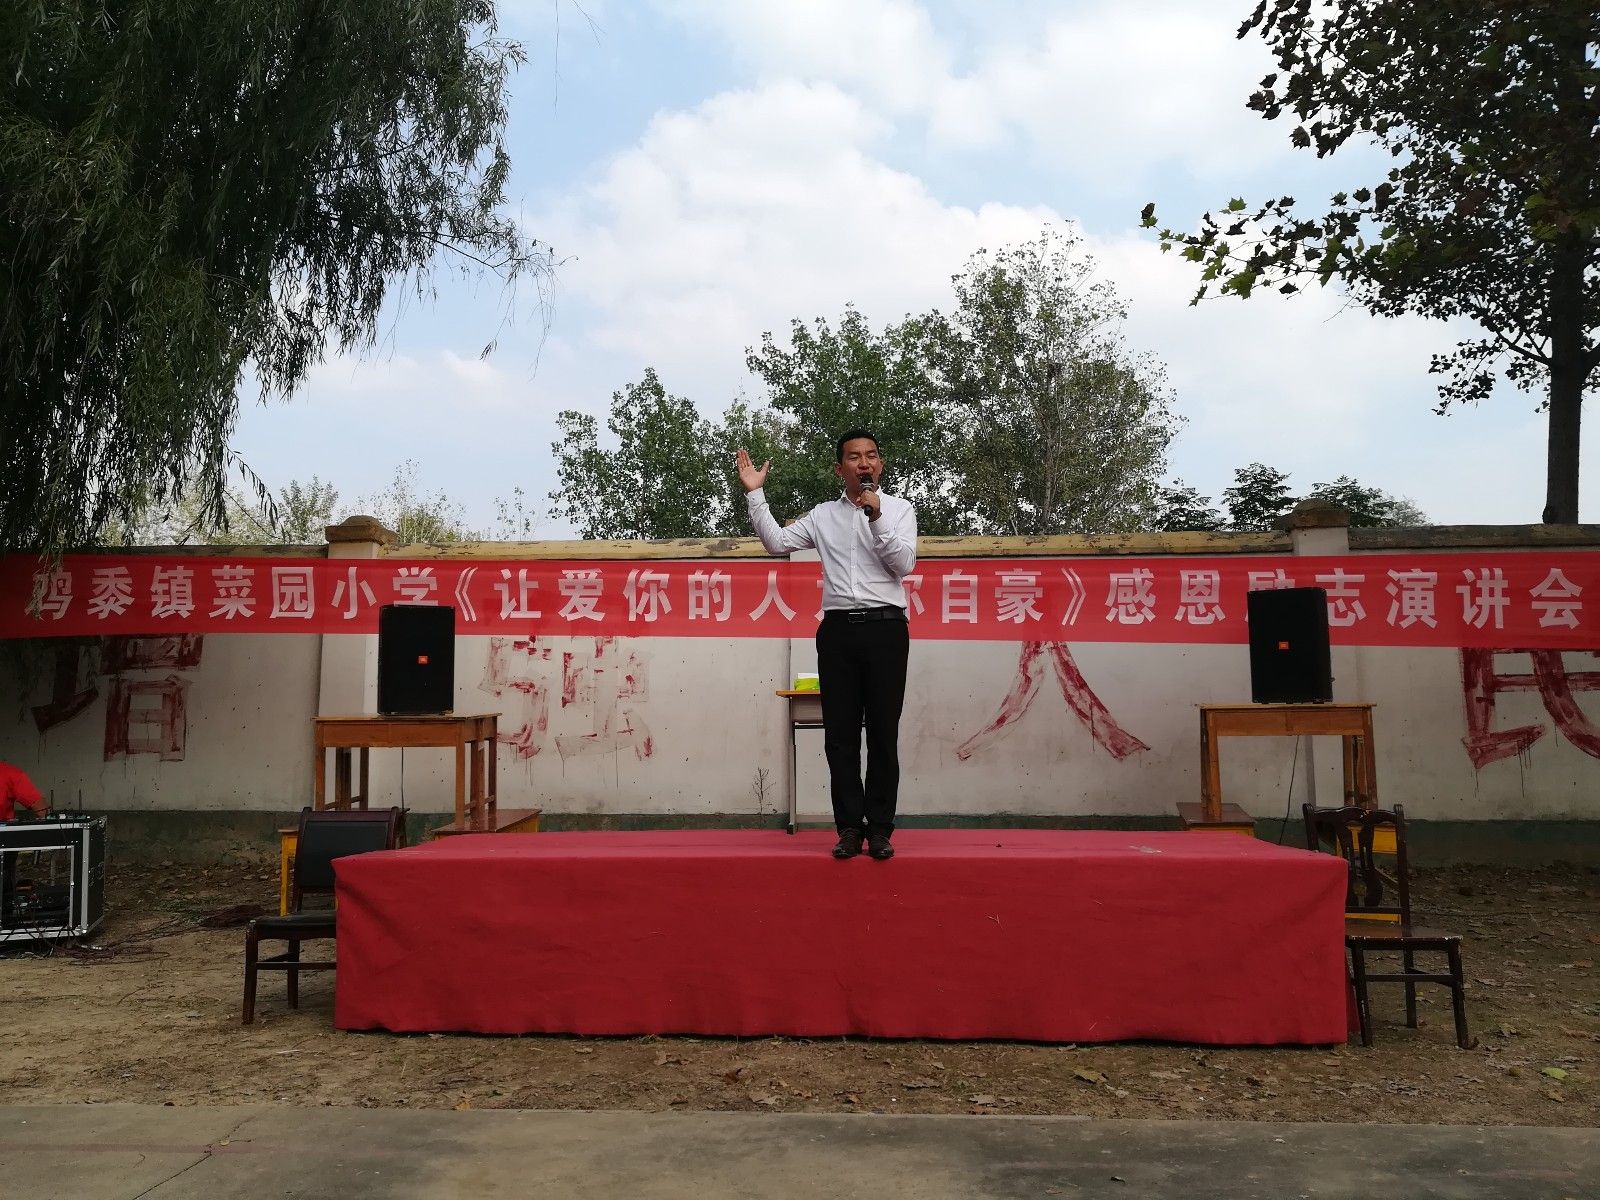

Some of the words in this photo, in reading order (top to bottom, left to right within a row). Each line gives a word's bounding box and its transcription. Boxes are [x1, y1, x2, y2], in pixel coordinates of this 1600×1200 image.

[24, 565, 1583, 630] 鸡黍镇菜园小学《让爱你的人自豪》感恩志演讲会
